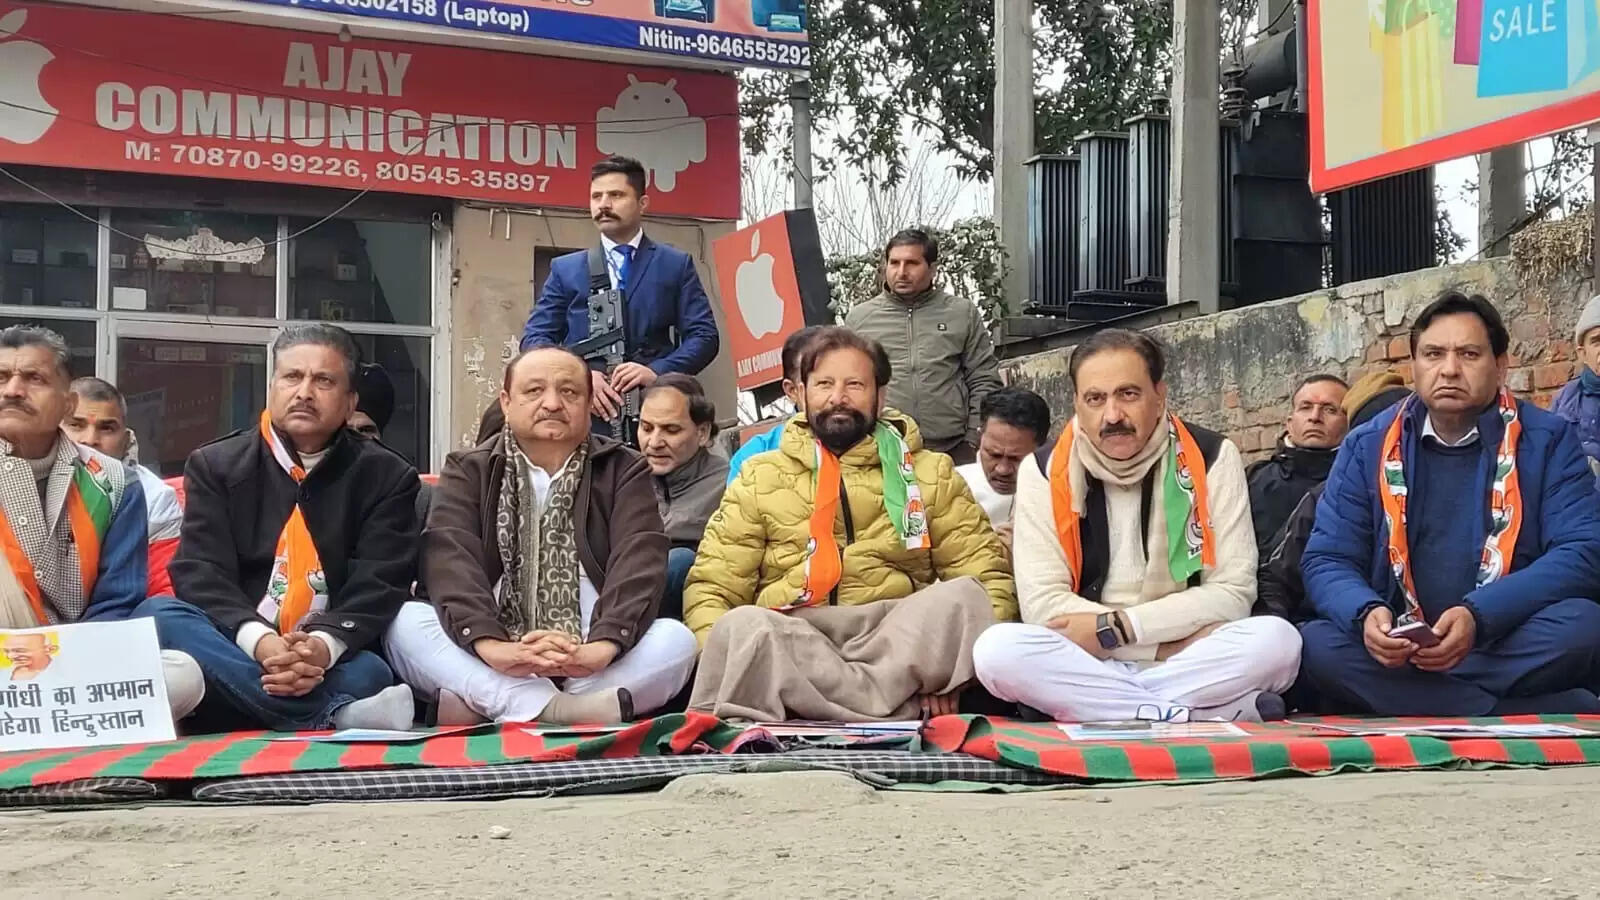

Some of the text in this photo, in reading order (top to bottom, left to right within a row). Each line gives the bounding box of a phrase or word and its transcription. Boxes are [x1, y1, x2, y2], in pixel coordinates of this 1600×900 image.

[444, 1, 530, 32] (Laptop)
[1489, 0, 1557, 42] SALE
[282, 41, 412, 97] AJAY
[95, 80, 578, 170] COMMUNICATION
[124, 139, 551, 194] M: 70870-99226, 80545-35897
[52, 686, 76, 706] का
[86, 678, 155, 703] अपमान
[0, 711, 41, 736] हेगा
